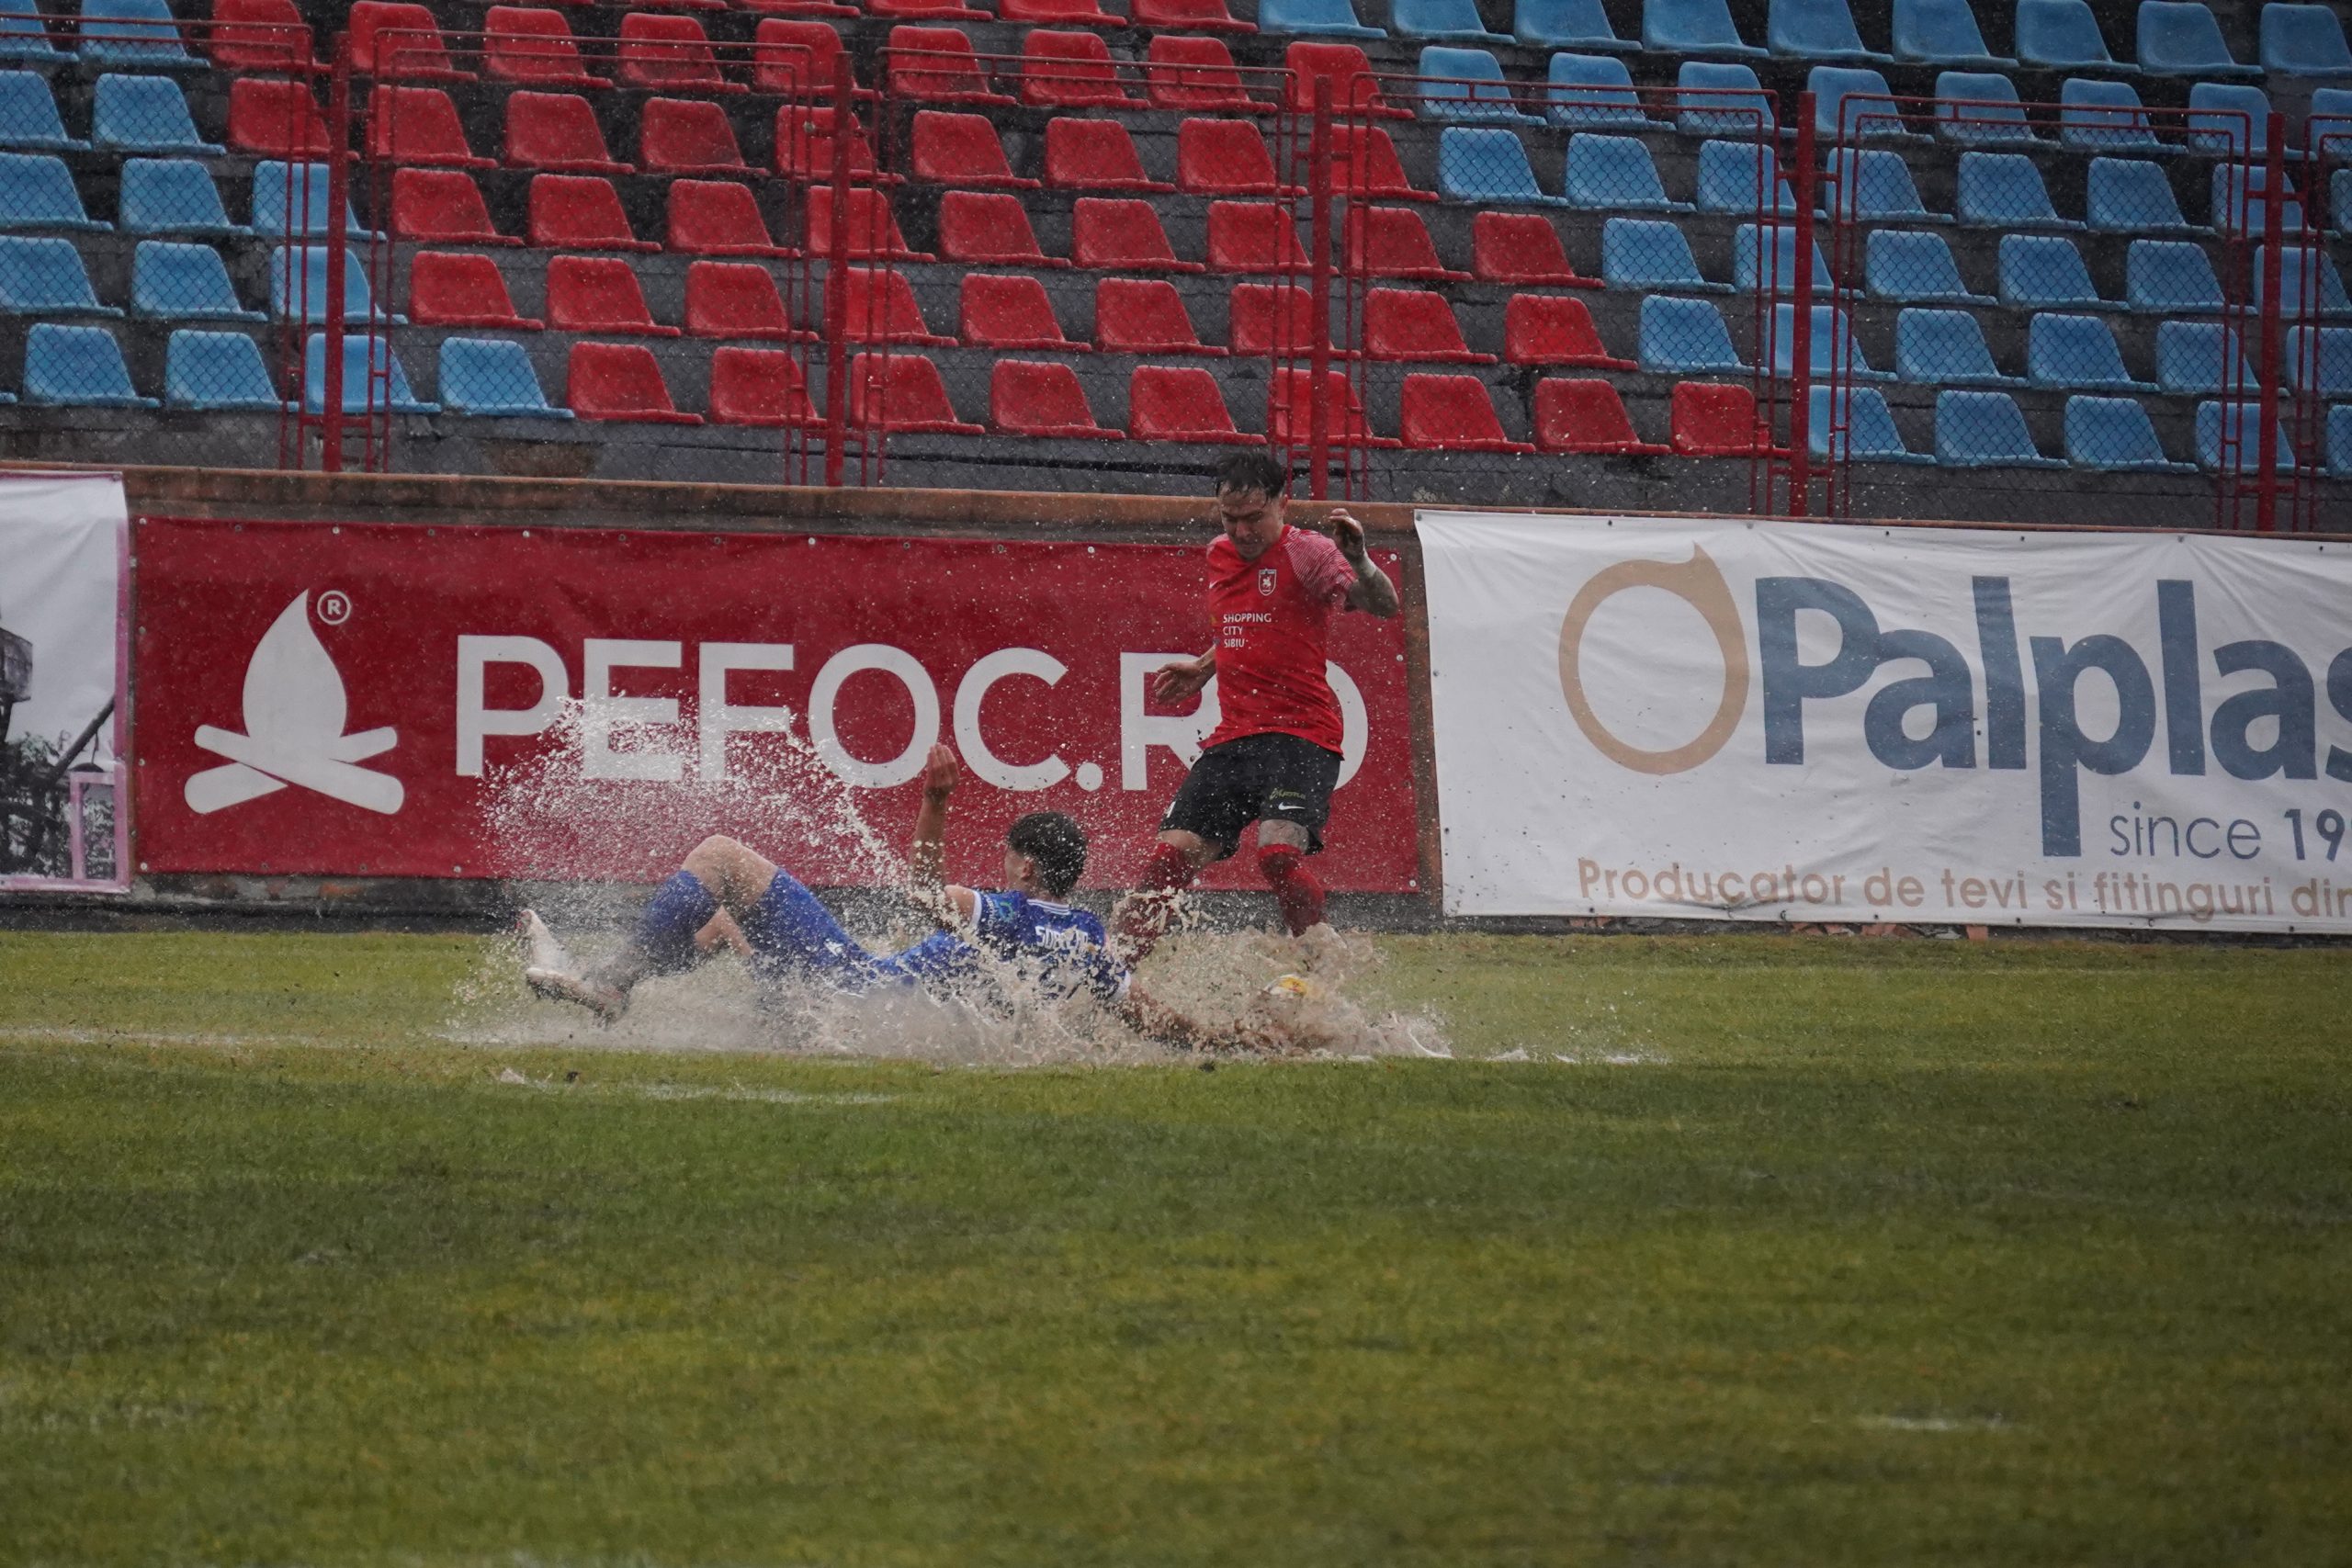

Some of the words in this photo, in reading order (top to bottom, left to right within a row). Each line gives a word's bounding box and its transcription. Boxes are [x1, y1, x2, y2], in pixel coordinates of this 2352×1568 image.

[1222, 613, 1272, 624] SHOPPING
[1222, 626, 1244, 636] CITY
[1223, 637, 1246, 649] SIBIU
[2109, 802, 2262, 860] since
[2284, 808, 2352, 863] 19
[1577, 857, 1847, 906] Producator
[1864, 866, 1925, 908] de
[1940, 868, 2029, 909] tevi
[2043, 871, 2076, 910] si
[2093, 872, 2275, 923] fitinguri
